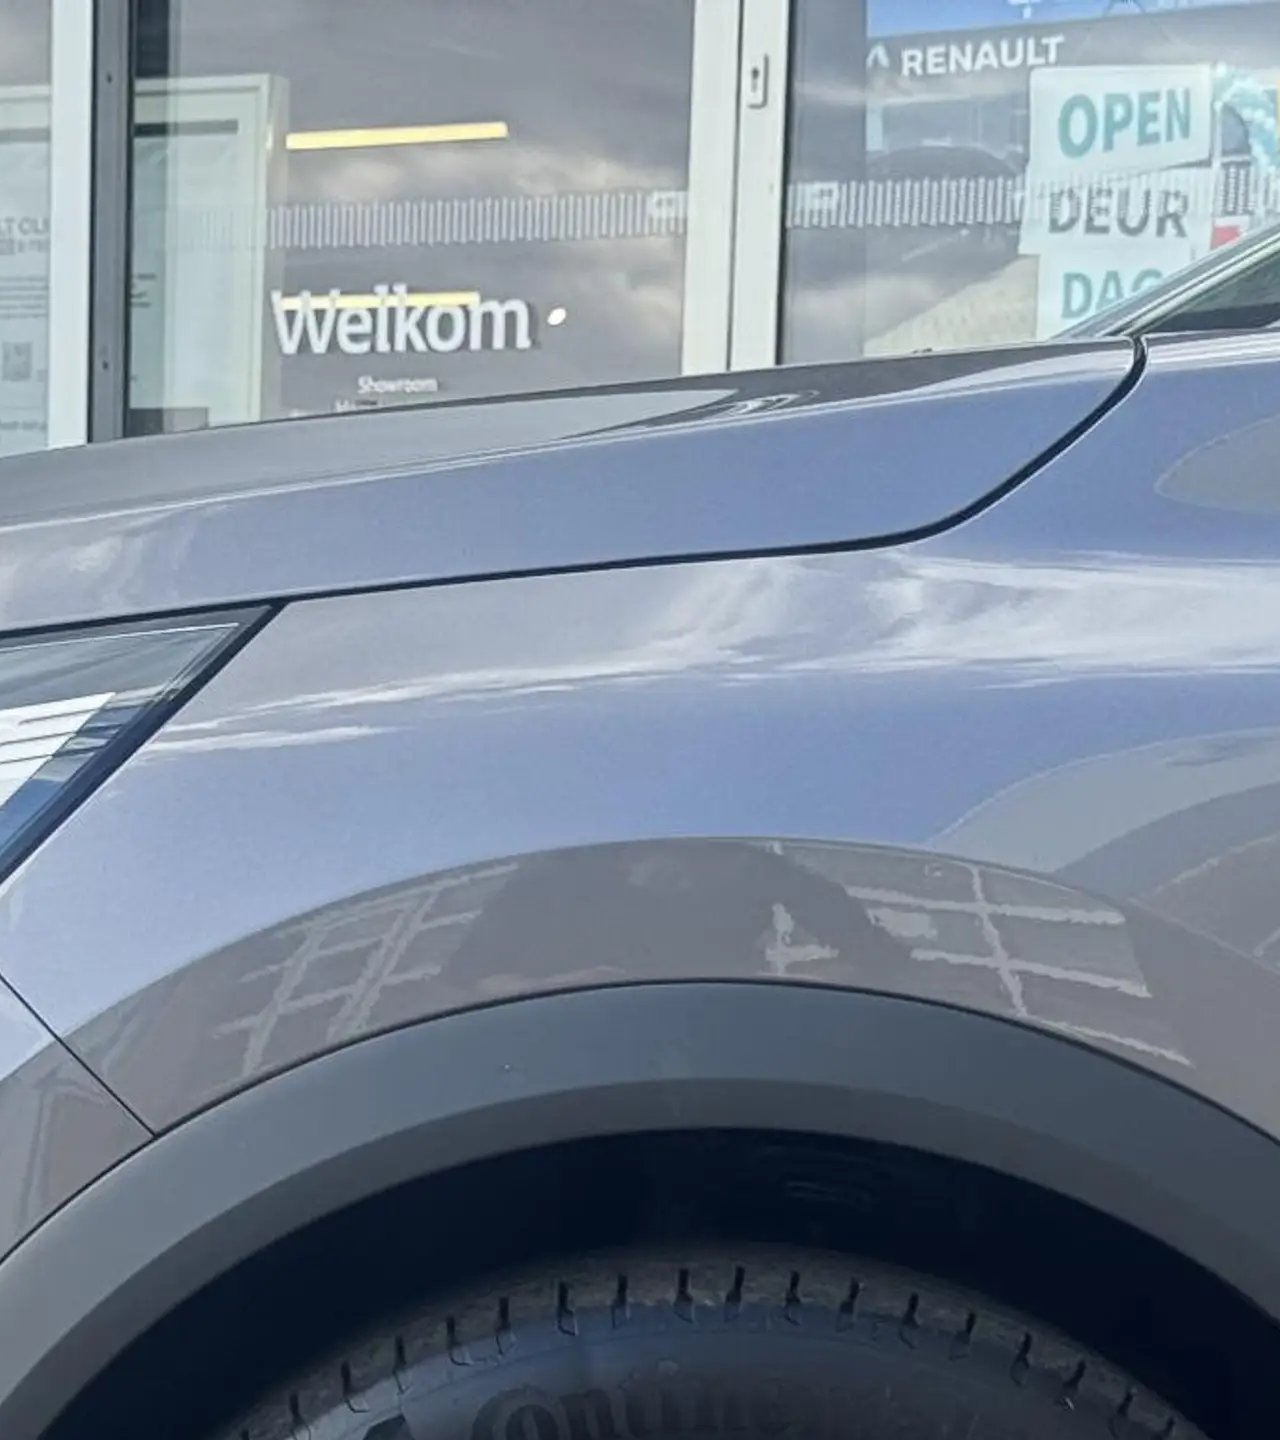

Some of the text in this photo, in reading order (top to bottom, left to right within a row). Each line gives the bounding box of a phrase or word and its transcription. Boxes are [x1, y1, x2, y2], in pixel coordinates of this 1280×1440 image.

[901, 35, 1065, 78] RENAULT
[1057, 87, 1191, 159] OPEN
[1047, 183, 1190, 238] DEUR
[270, 283, 532, 354] Welkom
[357, 375, 439, 394] Showroom
